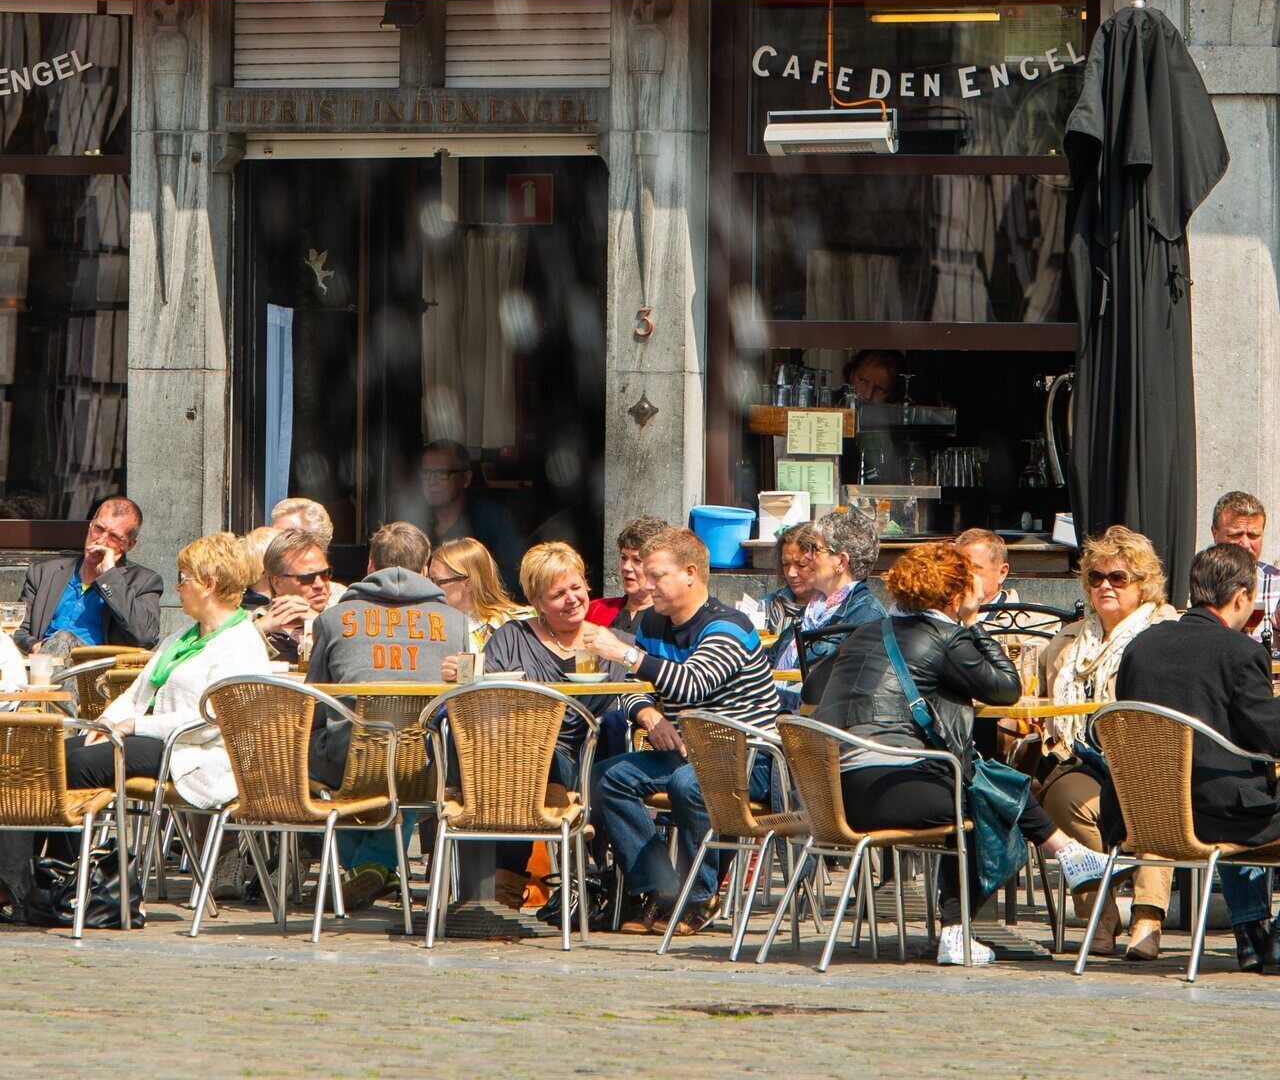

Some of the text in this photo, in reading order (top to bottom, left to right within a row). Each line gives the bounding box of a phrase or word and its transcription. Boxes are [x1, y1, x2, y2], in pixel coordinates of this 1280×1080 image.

[752, 41, 1086, 99] CAFE DEN ENGEL
[225, 98, 297, 122] HIER
[414, 98, 480, 122] DEN
[489, 98, 599, 122] ENGEL
[635, 307, 654, 336] 3
[342, 608, 447, 641] SUPER
[373, 643, 419, 670] DRY
